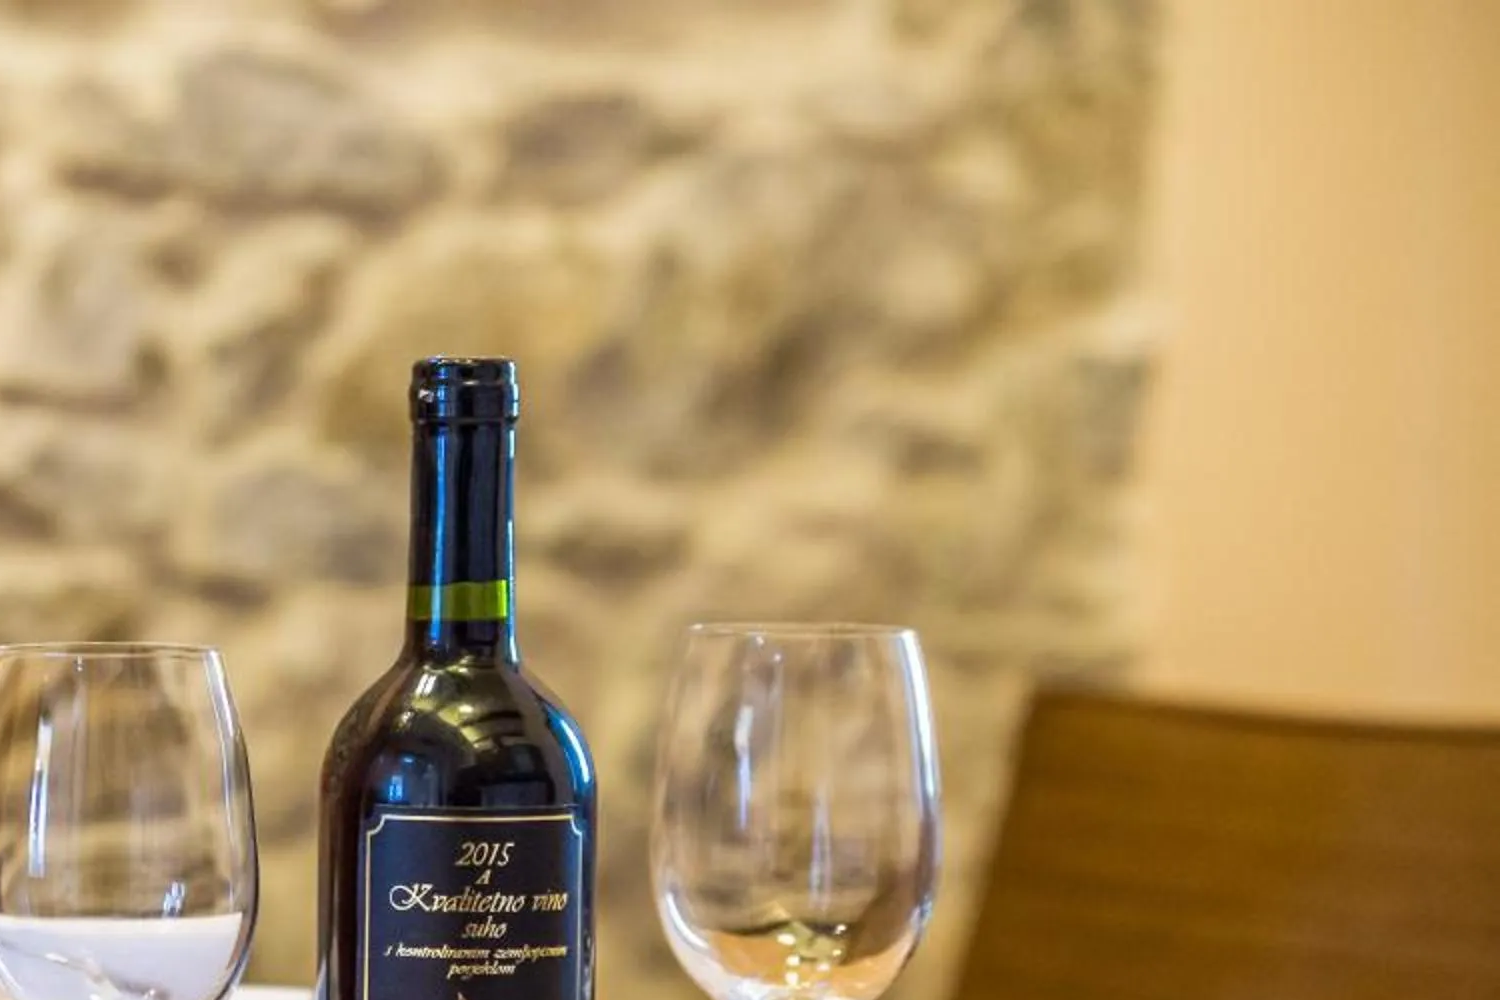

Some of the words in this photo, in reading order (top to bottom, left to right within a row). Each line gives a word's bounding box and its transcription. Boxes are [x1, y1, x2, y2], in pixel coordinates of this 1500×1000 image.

[455, 842, 514, 866] 2015
[475, 869, 492, 884] A
[389, 883, 525, 912] Kvalitetno
[531, 889, 568, 912] vino
[462, 916, 507, 938] suho
